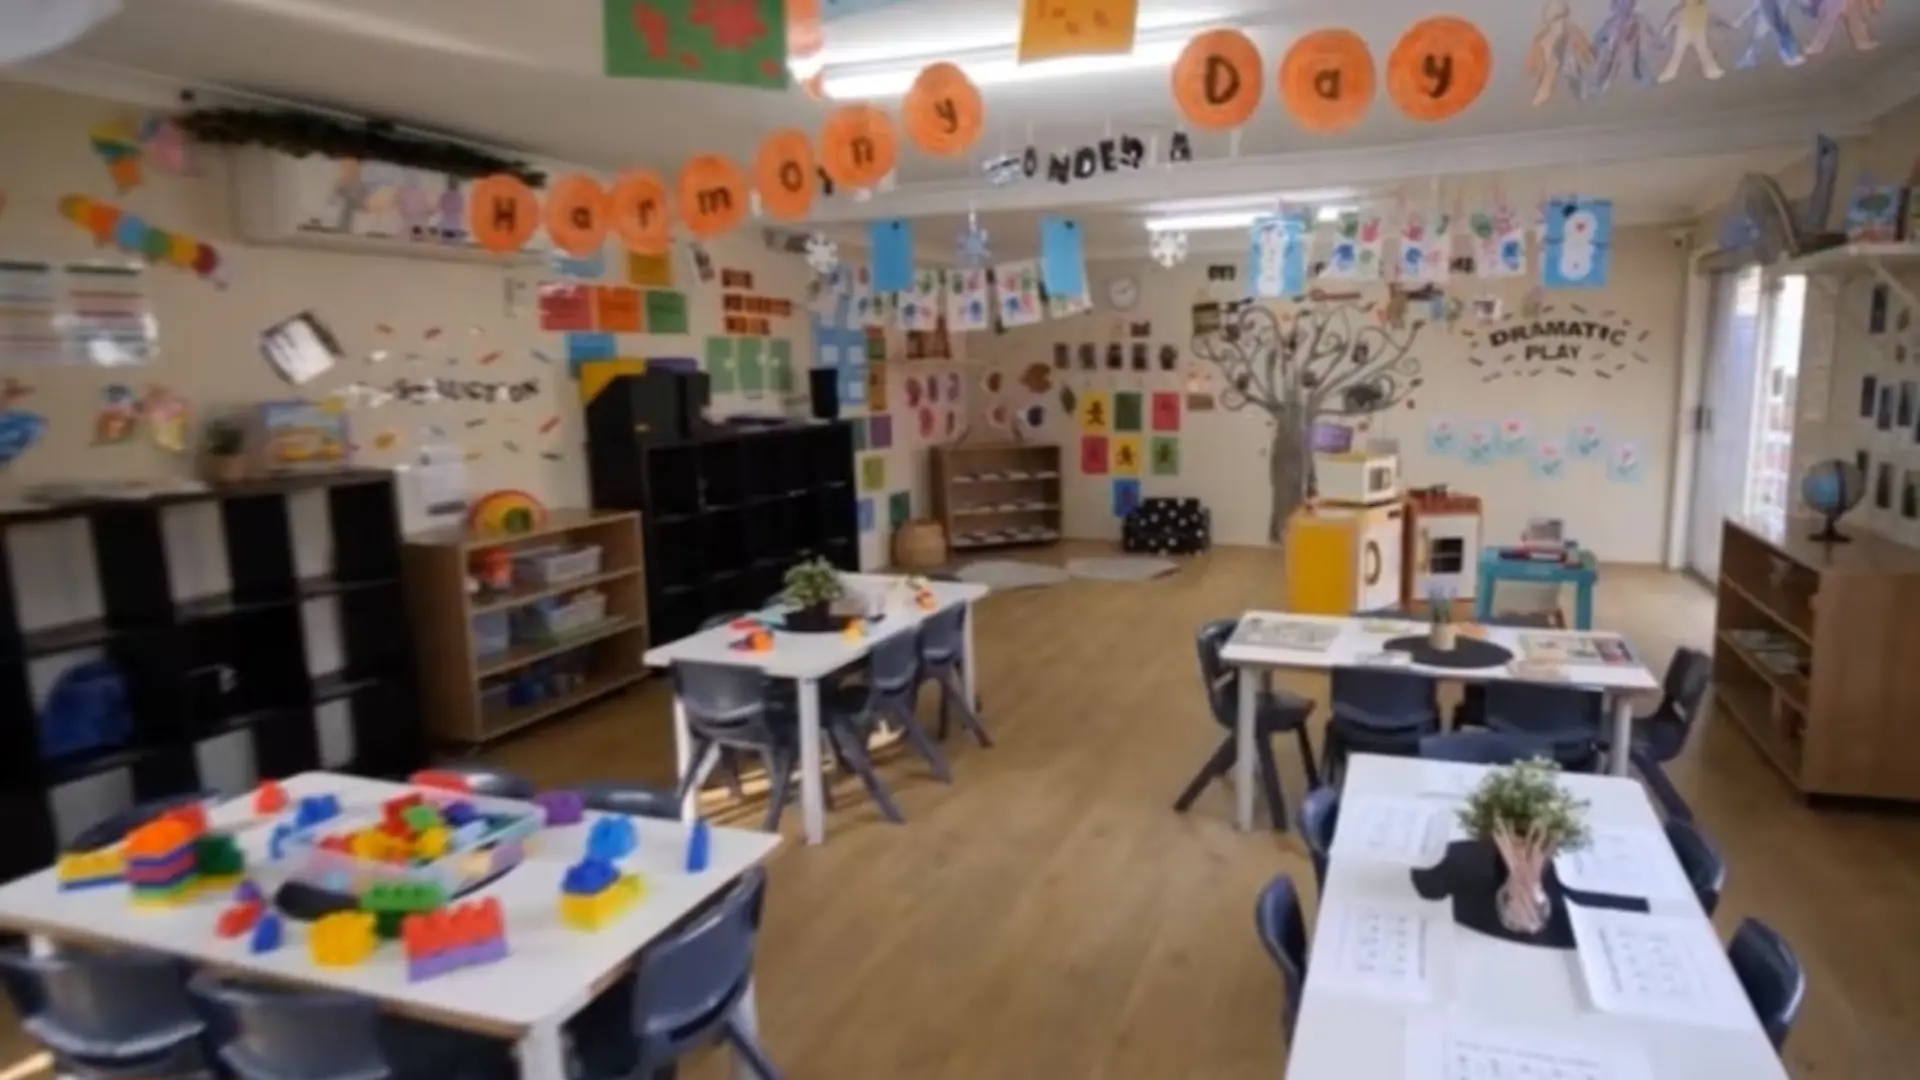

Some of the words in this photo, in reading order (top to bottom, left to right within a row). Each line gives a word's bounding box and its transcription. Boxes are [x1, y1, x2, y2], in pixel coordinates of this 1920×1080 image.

[492, 96, 960, 234] Harmony
[1203, 53, 1453, 102] Day
[984, 134, 1145, 186] ONDER
[1489, 310, 1628, 348] DRAMATIC
[1524, 343, 1582, 361] PLAY
